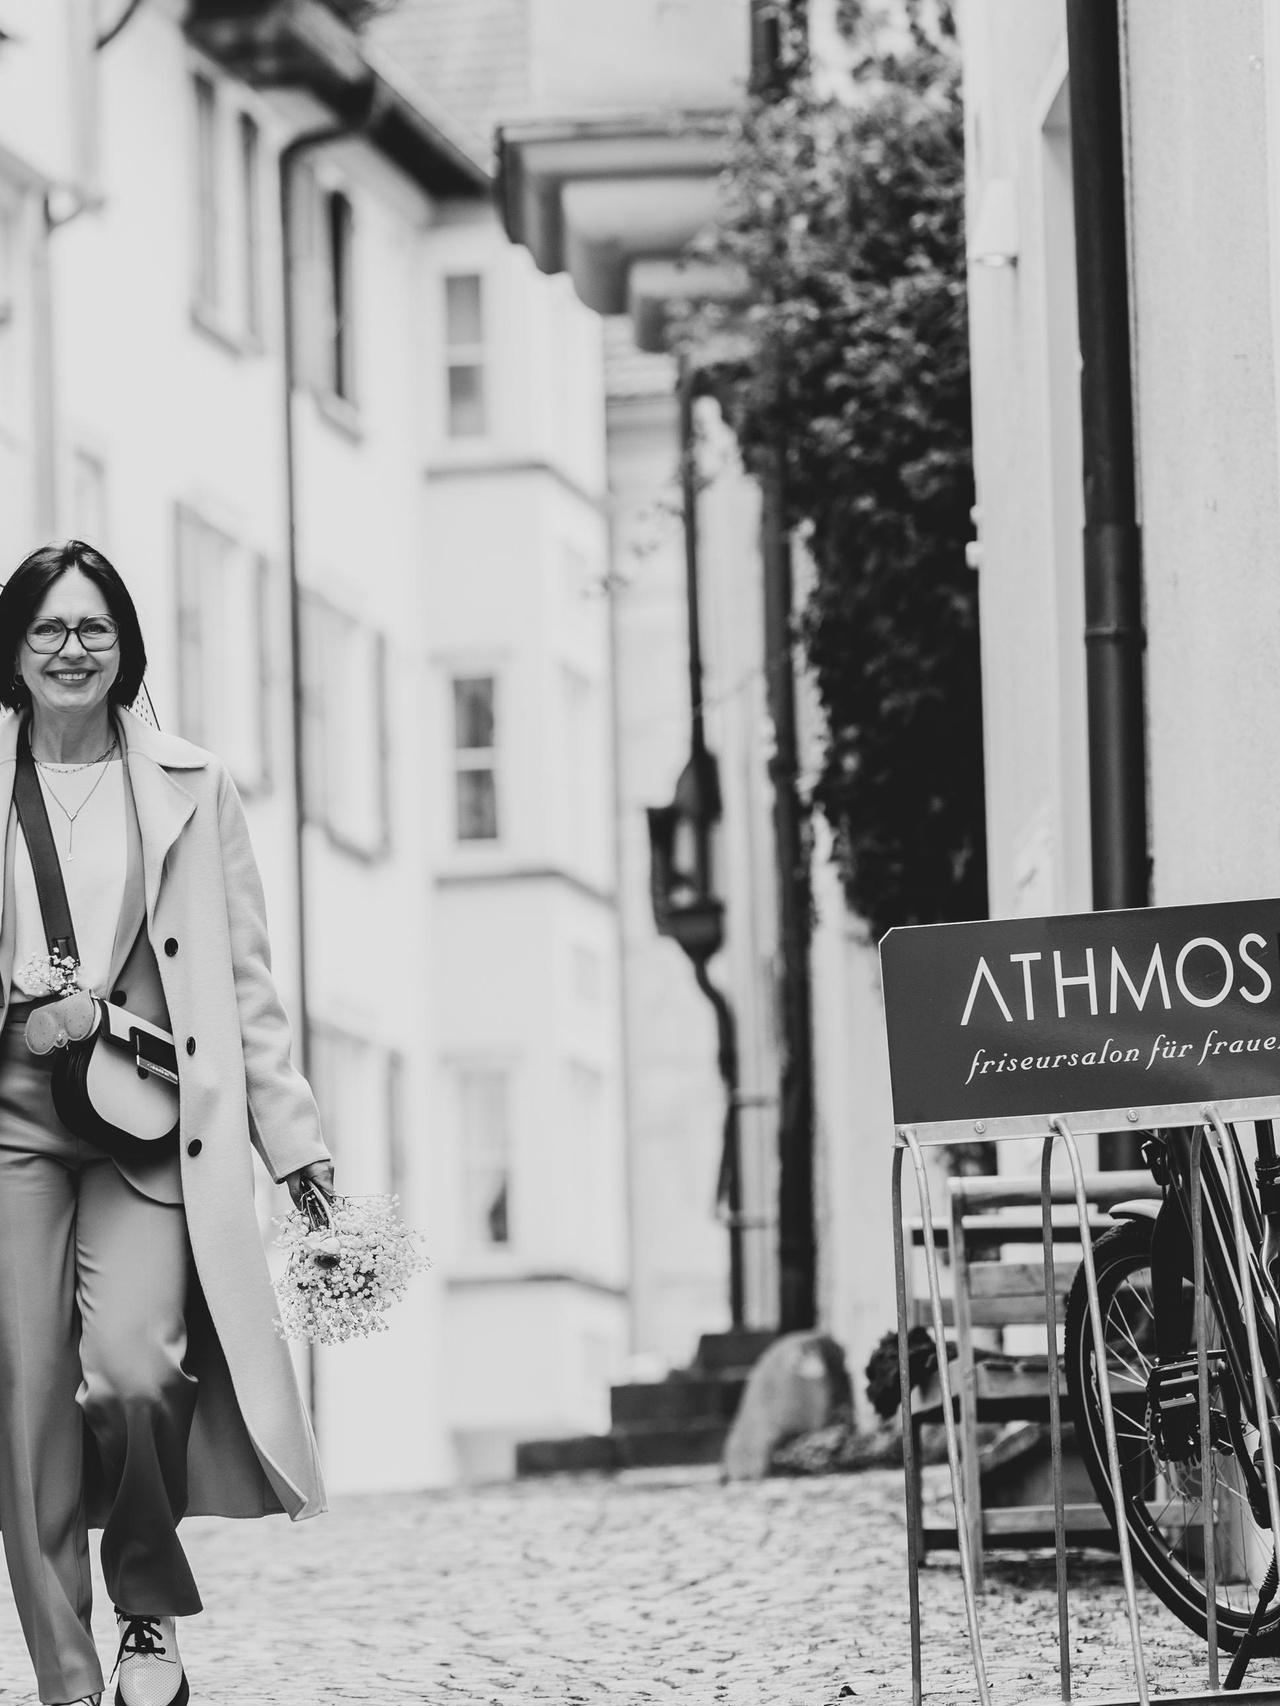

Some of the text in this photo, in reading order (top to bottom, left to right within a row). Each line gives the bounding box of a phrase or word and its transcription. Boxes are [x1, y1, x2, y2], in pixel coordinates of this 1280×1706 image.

[960, 932, 1272, 1026] ATHMOS
[964, 1029, 1280, 1085] friseursalon für fraue
